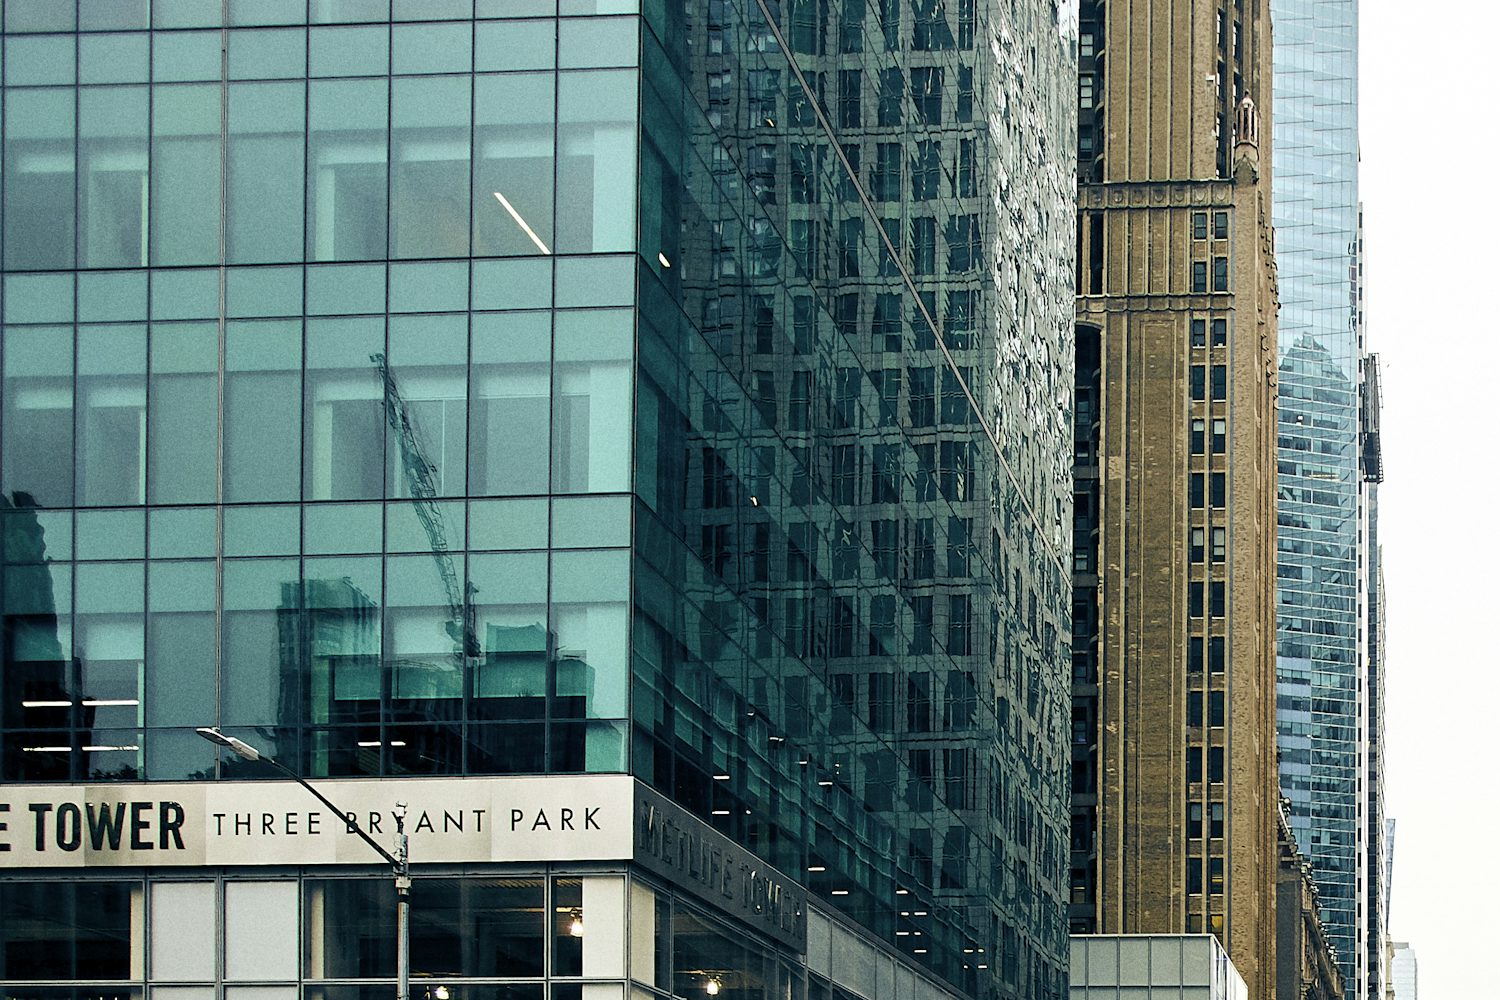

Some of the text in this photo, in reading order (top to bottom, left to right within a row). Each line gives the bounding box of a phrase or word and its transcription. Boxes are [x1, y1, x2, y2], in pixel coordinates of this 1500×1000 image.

[28, 801, 186, 851] TOWER
[213, 807, 602, 835] THREE BRYANT PARK
